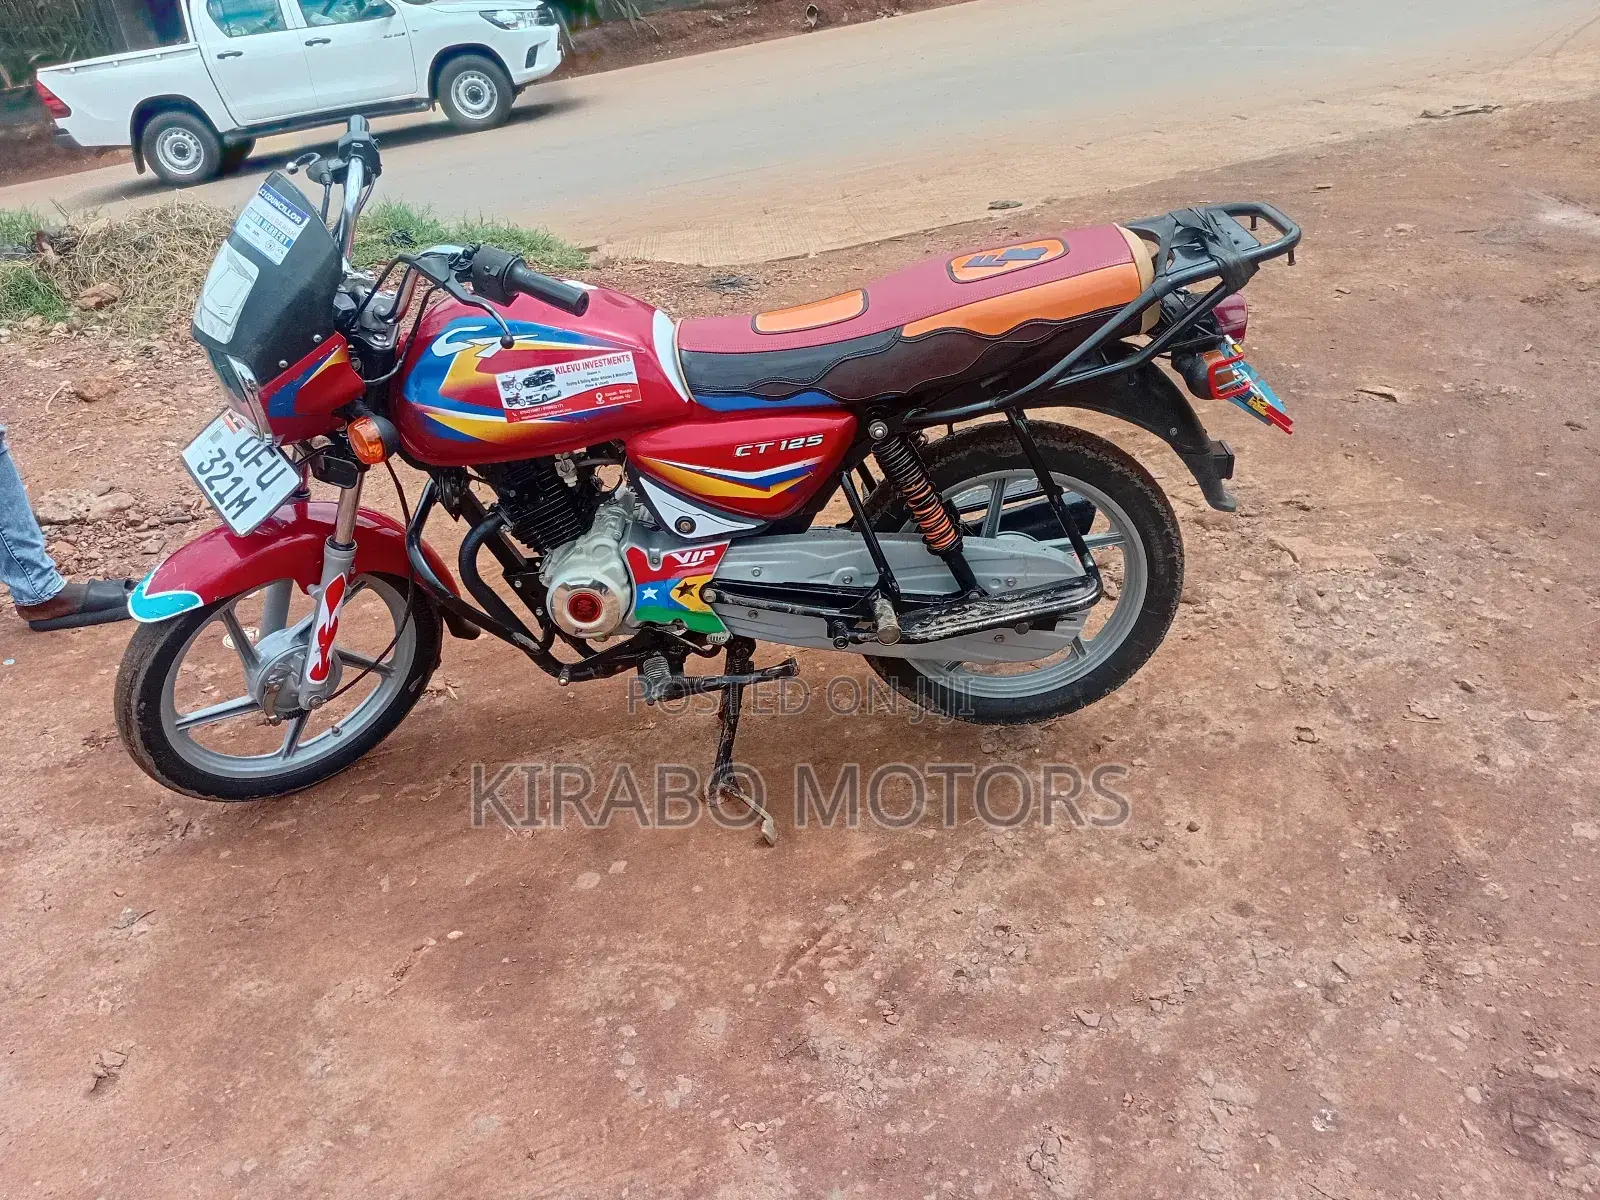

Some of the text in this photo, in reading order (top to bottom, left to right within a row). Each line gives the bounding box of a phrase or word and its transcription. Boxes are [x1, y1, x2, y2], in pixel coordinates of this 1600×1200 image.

[265, 192, 302, 224] COUNCILLOR
[555, 354, 631, 375] KILEVU INVESTMENTS
[734, 434, 824, 457] CT 125
[197, 448, 257, 520] 321M
[670, 550, 715, 565] VIP
